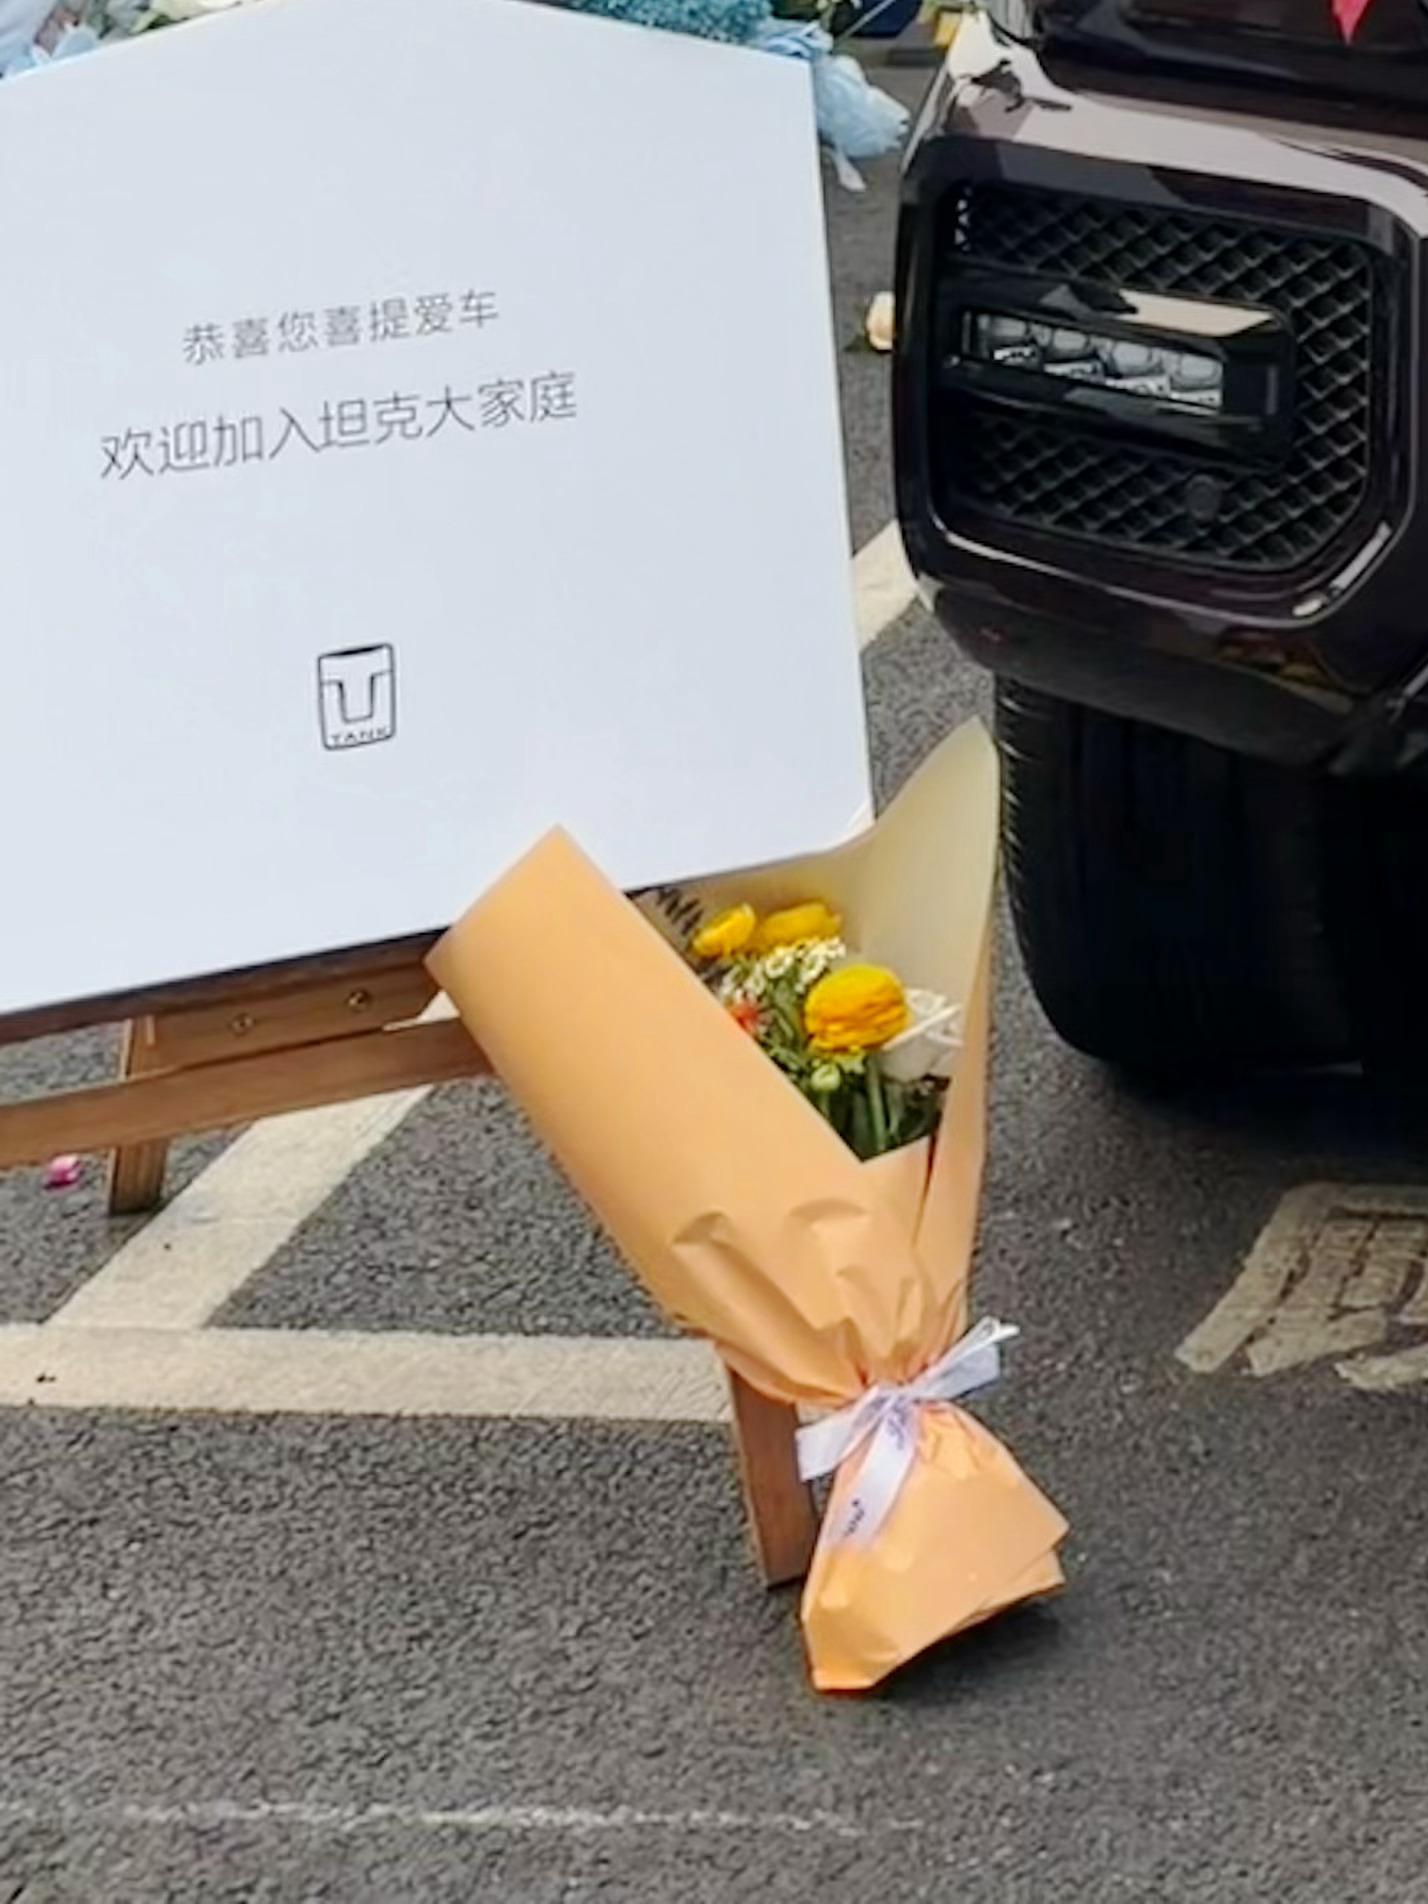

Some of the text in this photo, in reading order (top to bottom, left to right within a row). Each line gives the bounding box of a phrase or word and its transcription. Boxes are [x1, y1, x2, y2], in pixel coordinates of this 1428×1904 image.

[182, 288, 500, 367] 恭喜您喜提爱车
[100, 371, 578, 481] 欢迎加入坦克大家庭
